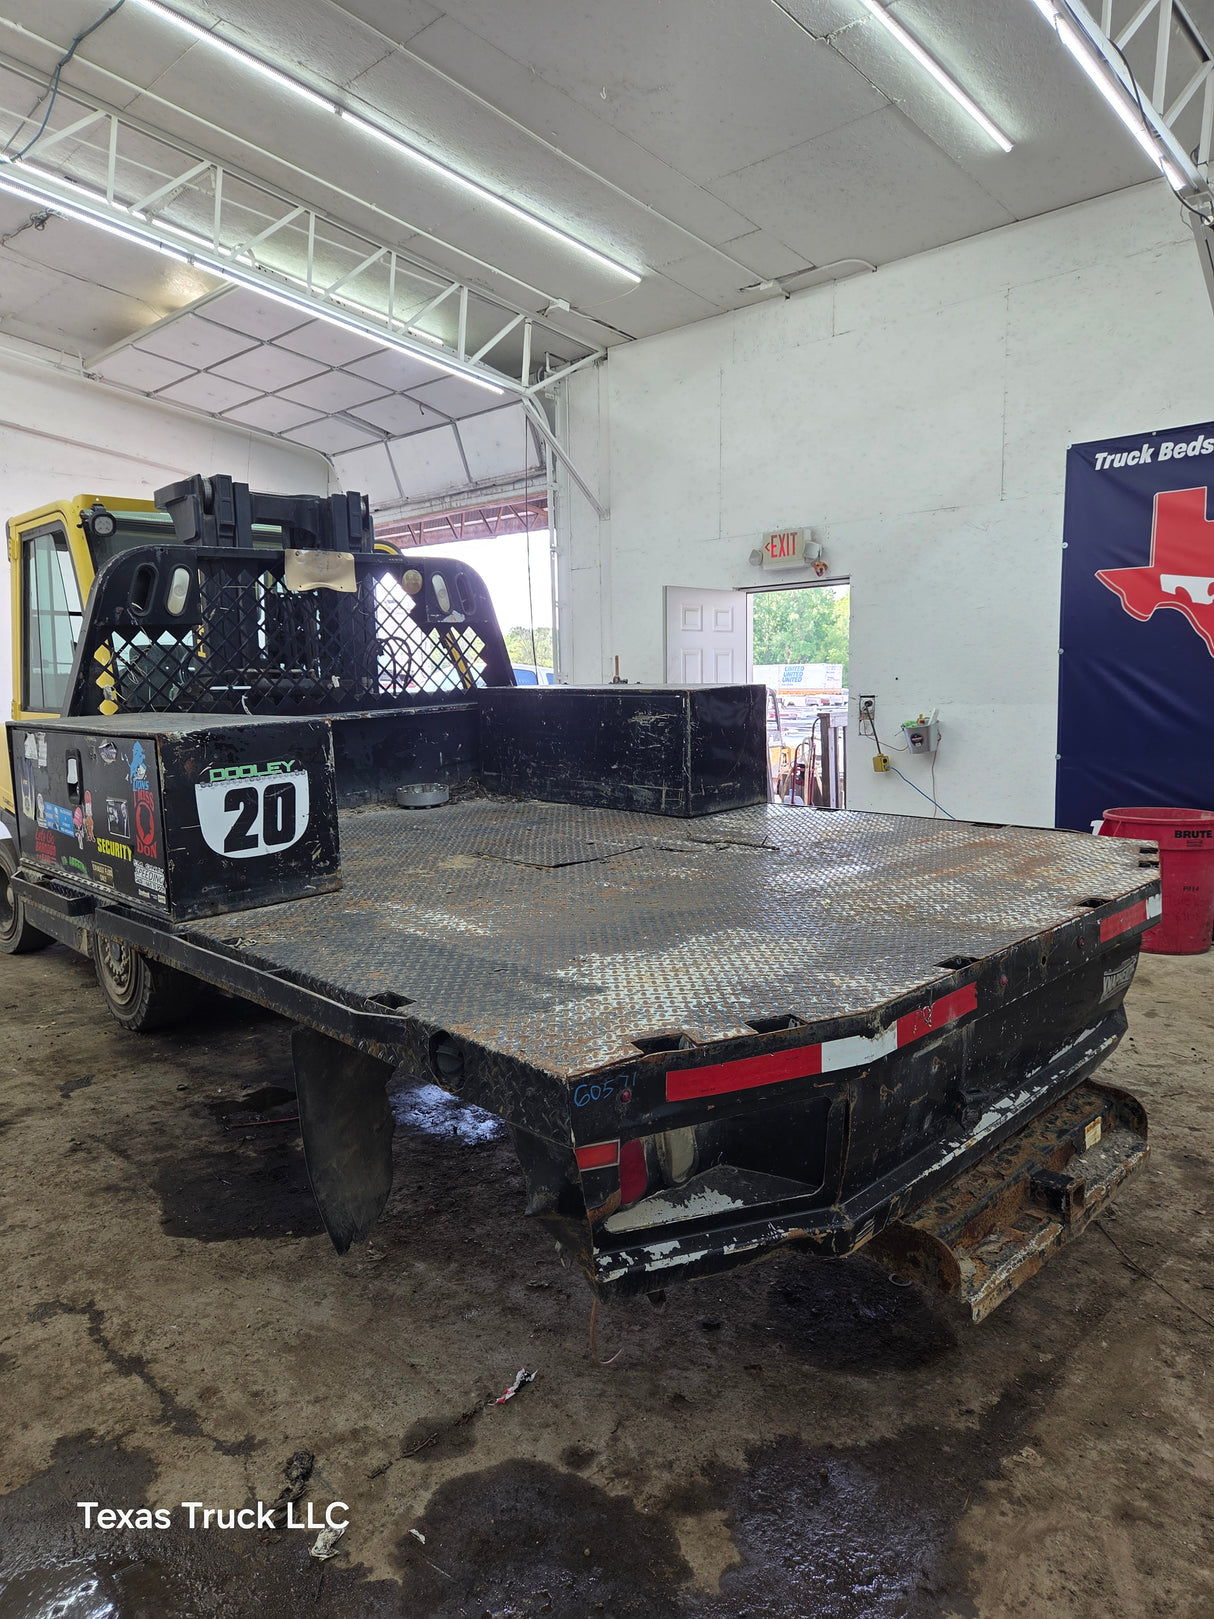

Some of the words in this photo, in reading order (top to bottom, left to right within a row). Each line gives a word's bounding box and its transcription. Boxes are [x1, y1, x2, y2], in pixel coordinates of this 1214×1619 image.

[1095, 444, 1155, 471] Truck
[1157, 435, 1214, 461] Beds
[771, 532, 797, 558] EXIT
[209, 759, 296, 782] DOOLEY
[132, 780, 150, 792] LIONS
[137, 789, 155, 811] MISS
[223, 782, 296, 853] 20
[1174, 830, 1212, 839] BRUTE
[96, 837, 132, 862] SECURITY
[136, 835, 157, 859] DON
[135, 867, 165, 886] SPEEDING
[573, 1071, 637, 1107] 60571
